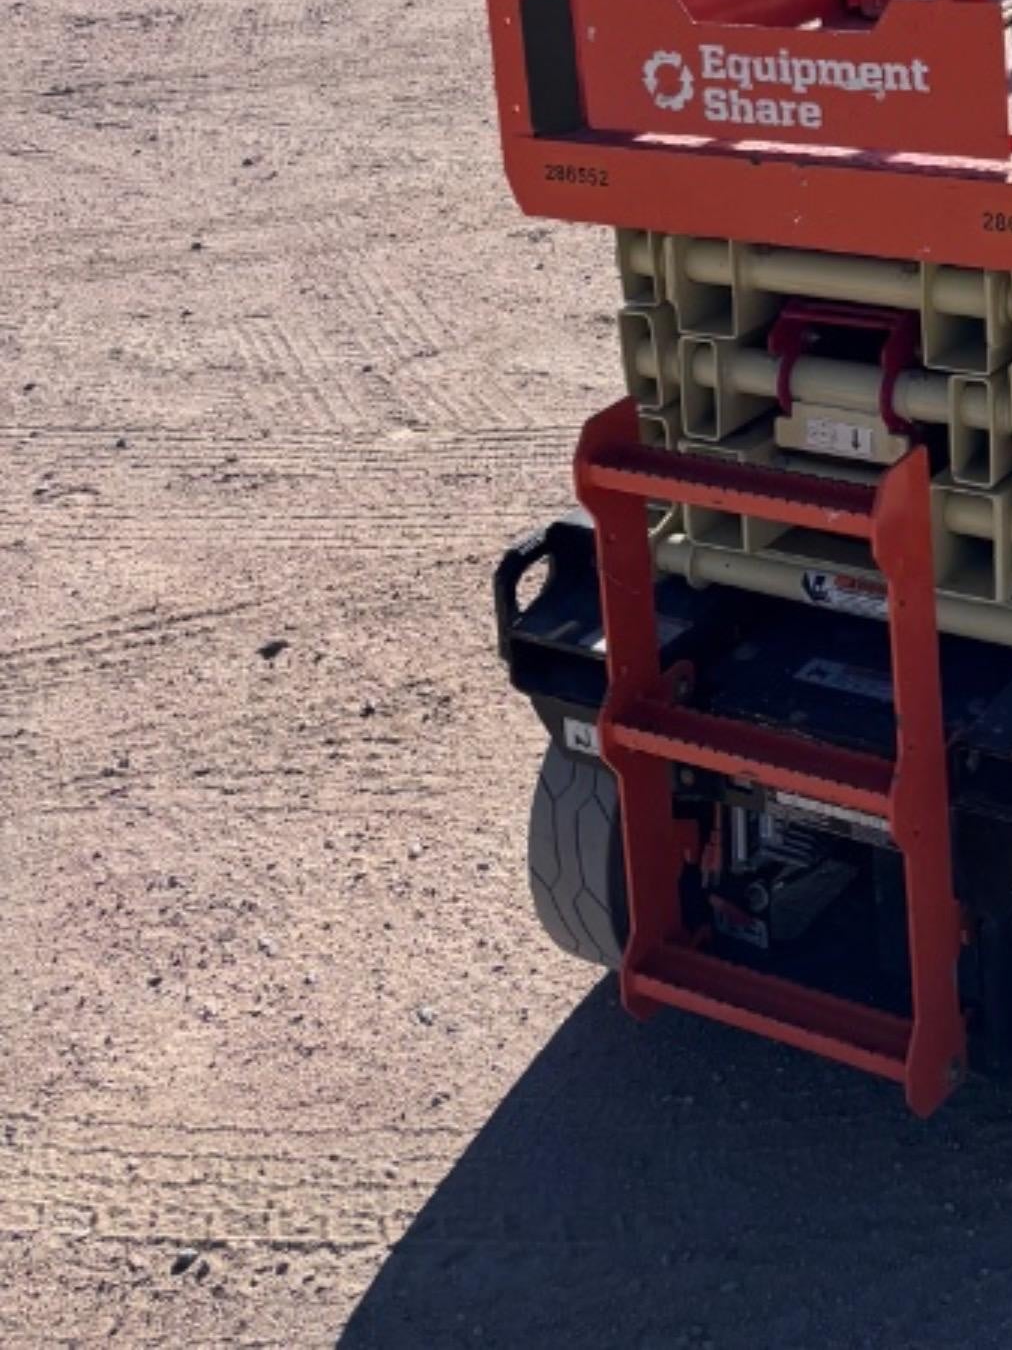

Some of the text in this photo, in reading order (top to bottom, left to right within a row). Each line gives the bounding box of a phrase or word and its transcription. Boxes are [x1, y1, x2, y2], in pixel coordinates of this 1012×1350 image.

[699, 43, 930, 94] Equipment
[702, 86, 824, 130] Share
[544, 163, 610, 188] 286552
